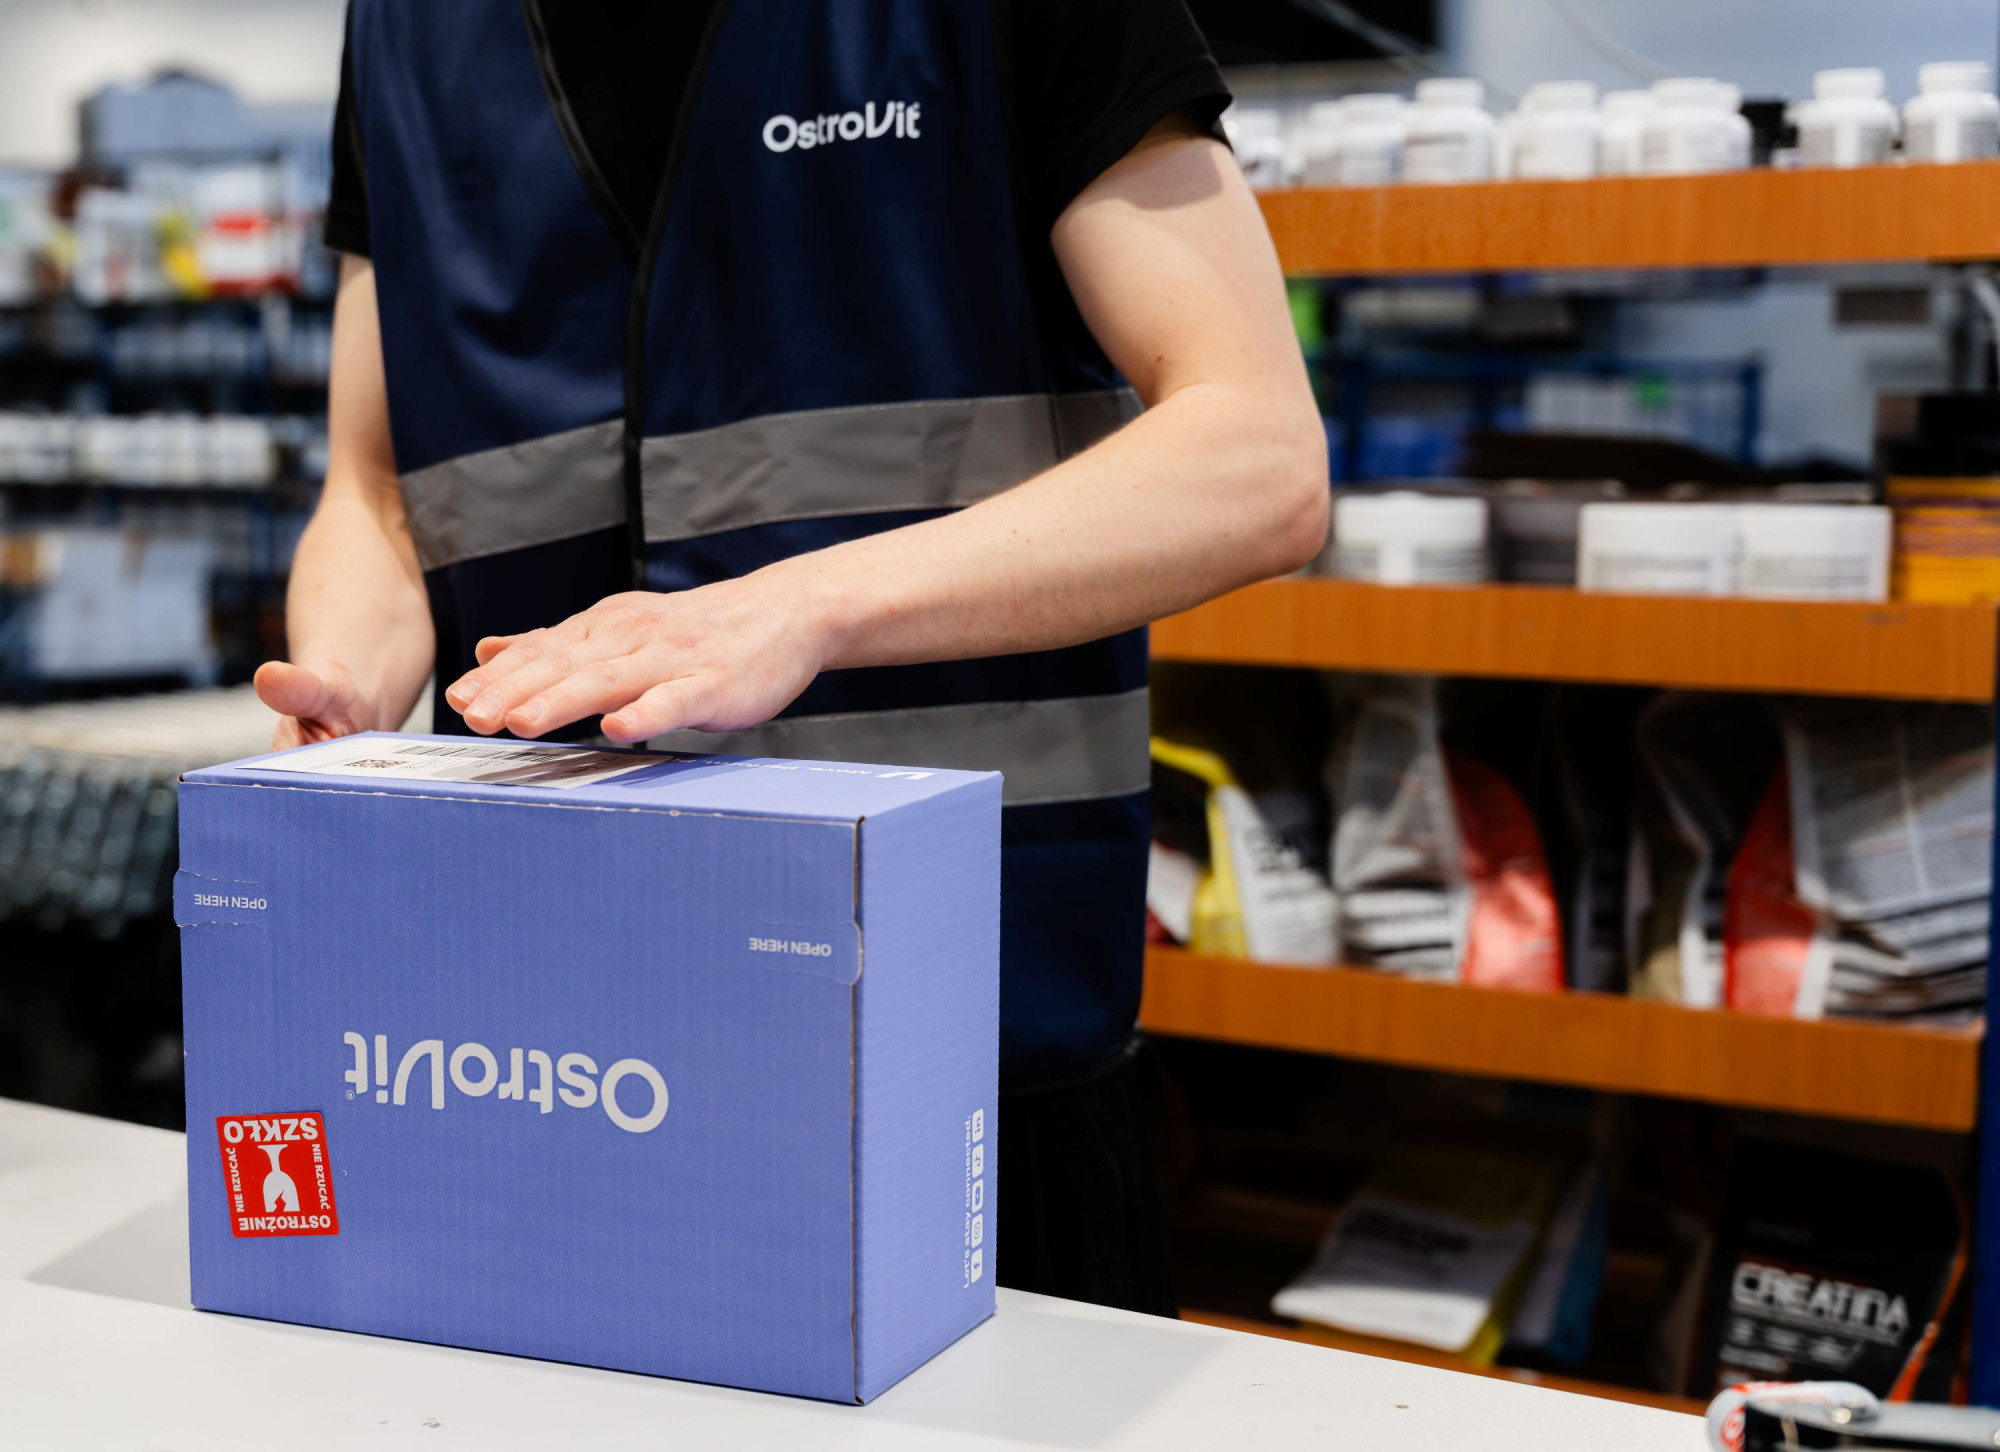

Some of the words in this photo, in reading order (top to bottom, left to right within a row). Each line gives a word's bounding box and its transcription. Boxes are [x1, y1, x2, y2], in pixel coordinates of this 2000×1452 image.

[762, 100, 921, 153] OstroVit
[194, 894, 228, 907] HERE
[231, 896, 267, 910] OPEN
[749, 937, 788, 953] HERE
[790, 941, 832, 957] OPEN
[223, 1117, 318, 1143] SZKŁO
[312, 1143, 323, 1163] NIE
[225, 1147, 242, 1192] RZUCAĆ
[315, 1164, 331, 1210] RZUCAĆ
[234, 1193, 245, 1213] NIE
[238, 1215, 331, 1233] OSTROŻNIE
